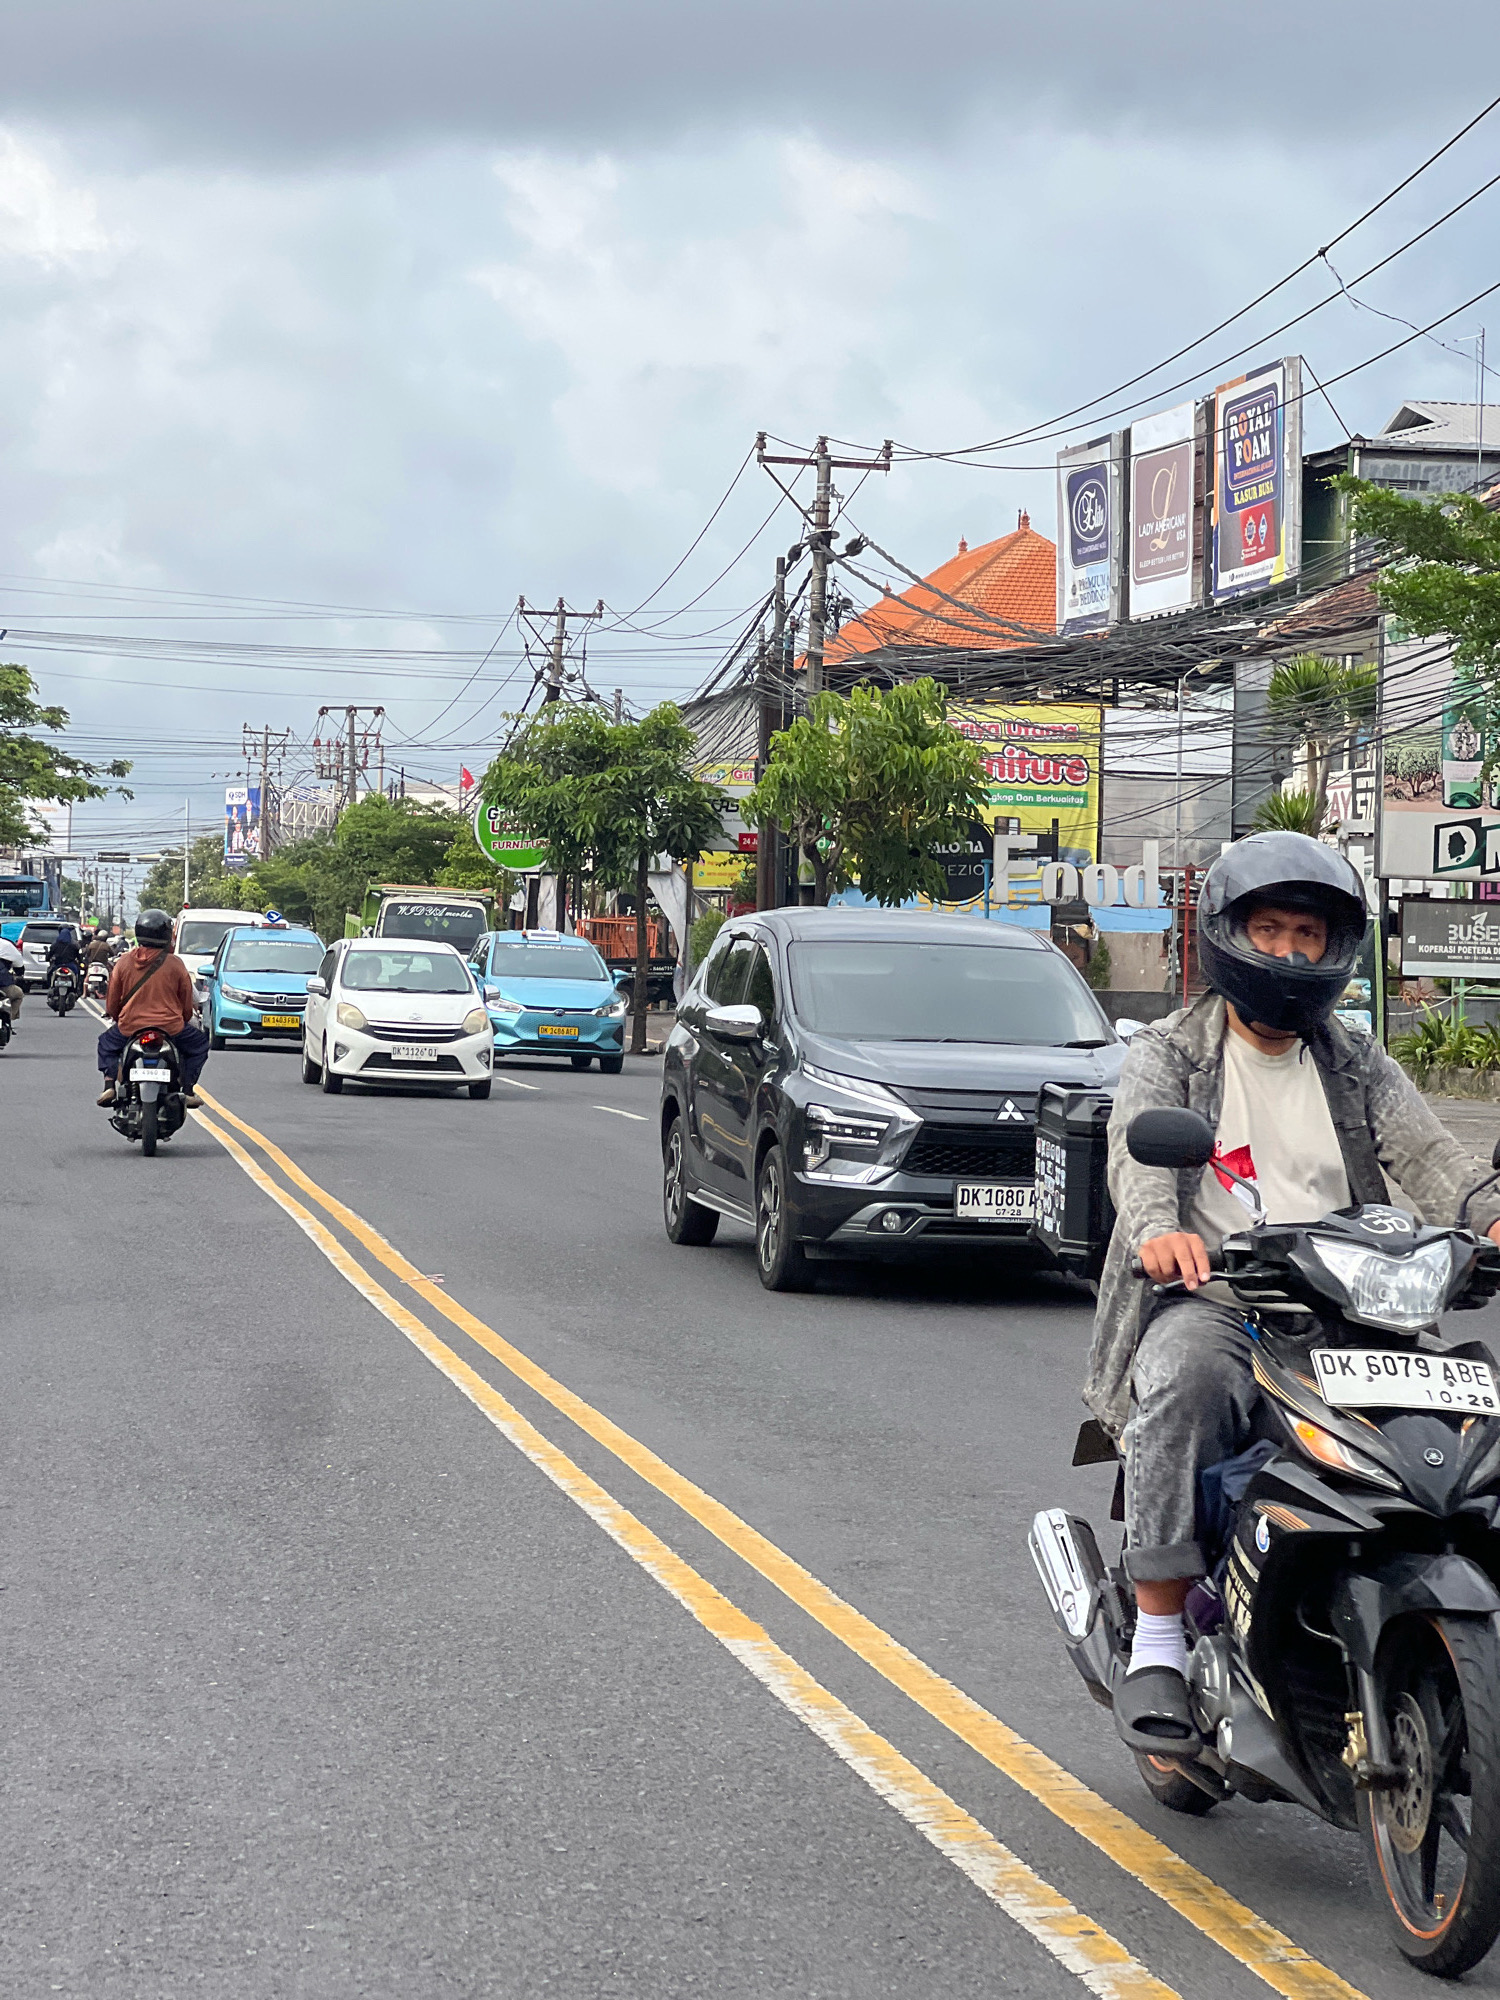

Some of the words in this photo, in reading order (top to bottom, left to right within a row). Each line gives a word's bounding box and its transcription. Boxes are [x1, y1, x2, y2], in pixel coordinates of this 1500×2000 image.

[1229, 402, 1272, 440] ROYAL
[1234, 431, 1270, 467] FOAM
[1233, 484, 1258, 506] KASUR
[1258, 480, 1274, 497] BUSA
[1138, 522, 1154, 538] LADY
[1154, 514, 1186, 534] AMERICANA
[1176, 529, 1187, 541] USA
[1015, 793, 1034, 802] Dan
[1036, 794, 1084, 804] Berkualitas
[742, 837, 751, 845] 24
[993, 834, 1160, 908] Food
[1418, 944, 1456, 954] KOPERASI
[1457, 946, 1492, 955] POETERA
[392, 1046, 402, 1056] DK
[405, 1047, 425, 1057] 1126
[959, 1188, 981, 1206] DK
[984, 1188, 1025, 1207] 1080
[1319, 1353, 1357, 1377] DK
[1365, 1355, 1431, 1378] 6079
[1443, 1361, 1490, 1388] ABE
